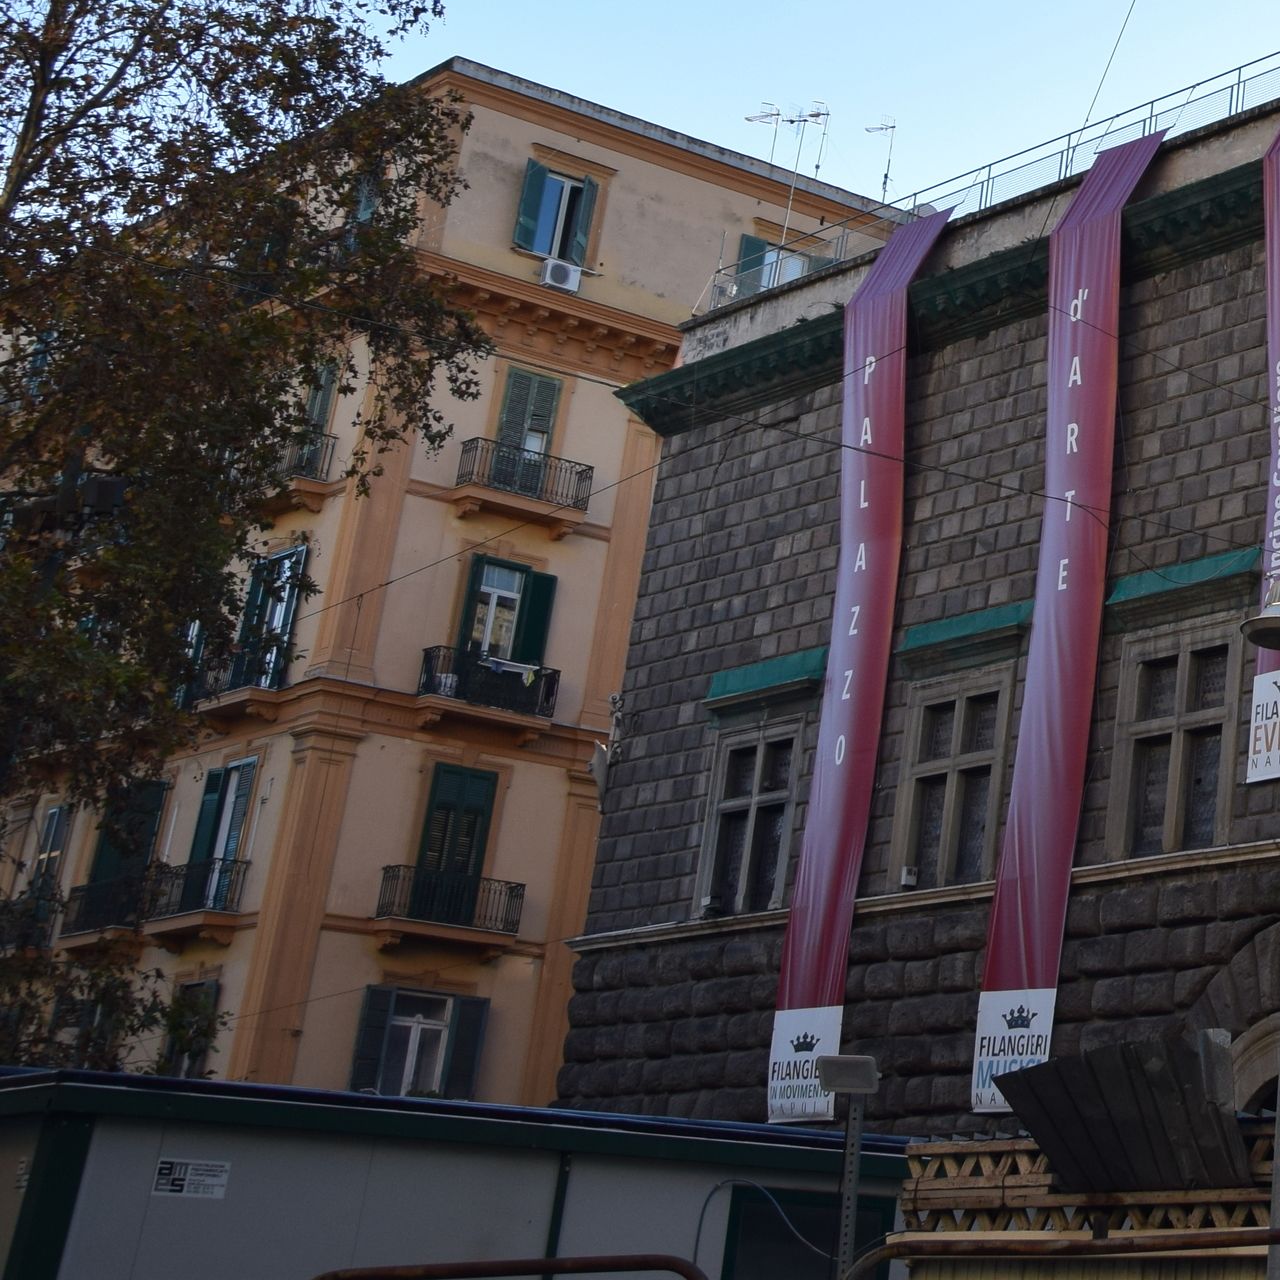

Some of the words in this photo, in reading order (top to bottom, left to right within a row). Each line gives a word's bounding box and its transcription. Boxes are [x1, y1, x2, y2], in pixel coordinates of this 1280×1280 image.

[835, 356, 876, 766] PALAZZO
[978, 1034, 1048, 1057] FILANGIERI
[771, 1059, 820, 1081] FILANGIE
